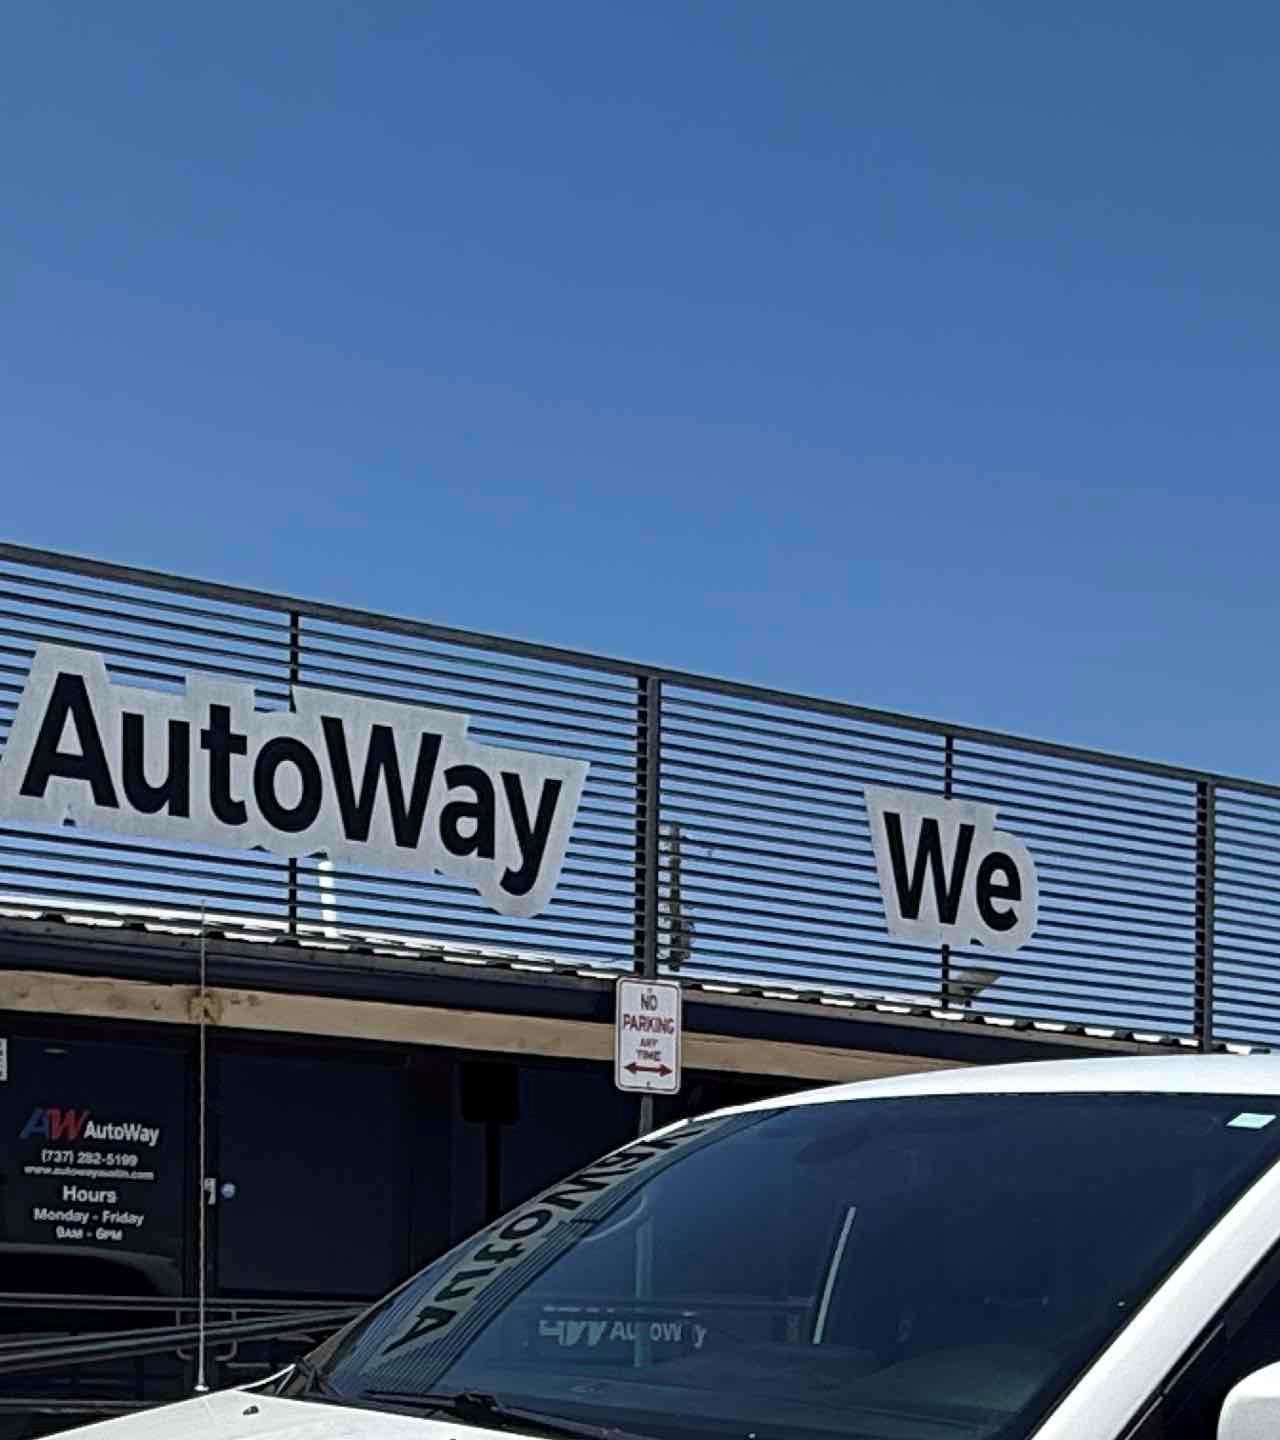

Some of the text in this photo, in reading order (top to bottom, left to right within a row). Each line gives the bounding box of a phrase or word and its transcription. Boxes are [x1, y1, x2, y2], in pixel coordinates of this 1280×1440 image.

[19, 672, 563, 898] AutoWay
[883, 811, 1022, 932] We
[640, 993, 658, 1012] NO
[623, 1014, 675, 1035] PARKING
[640, 1038, 658, 1049] ANY
[636, 1049, 662, 1061] TIME
[19, 1107, 160, 1147] AW AutoWay
[62, 1184, 117, 1203] Hours
[33, 1207, 90, 1224] Monday
[102, 1209, 145, 1227] Friday
